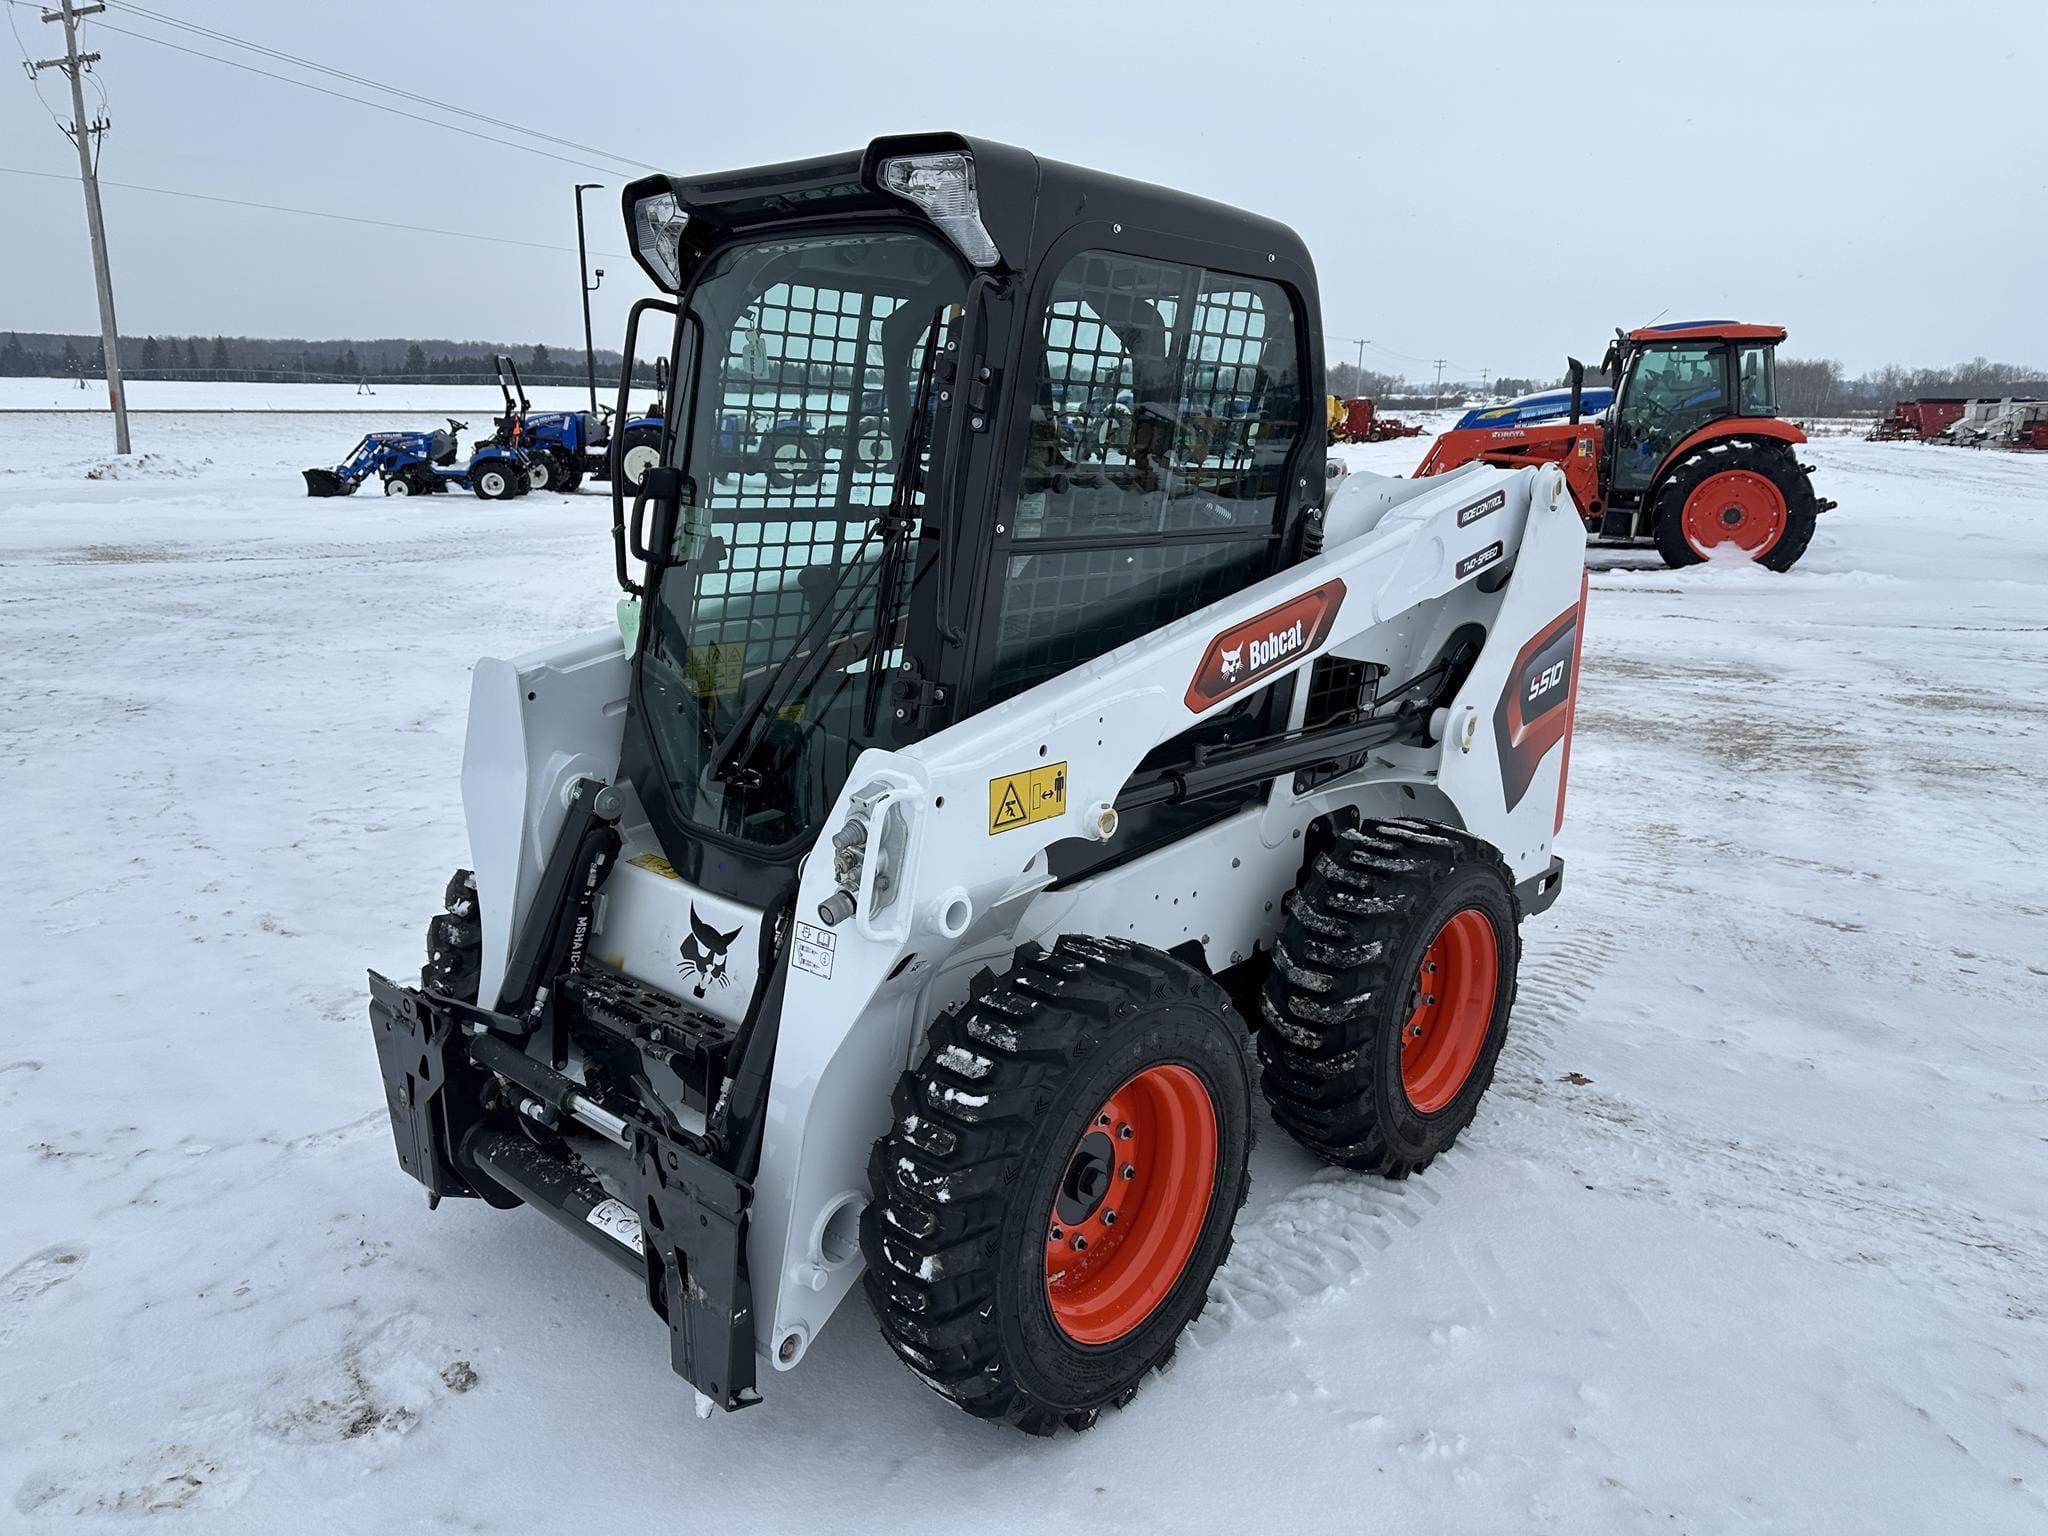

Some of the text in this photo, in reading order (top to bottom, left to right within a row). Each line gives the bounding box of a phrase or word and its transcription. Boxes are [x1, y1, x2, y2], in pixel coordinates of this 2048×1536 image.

[1537, 405, 1563, 416] Holland
[1491, 431, 1525, 439] KUBOTA
[1463, 546, 1498, 573] TWO-SPEED
[1249, 619, 1303, 671] Bobcat
[1528, 659, 1565, 702] S510
